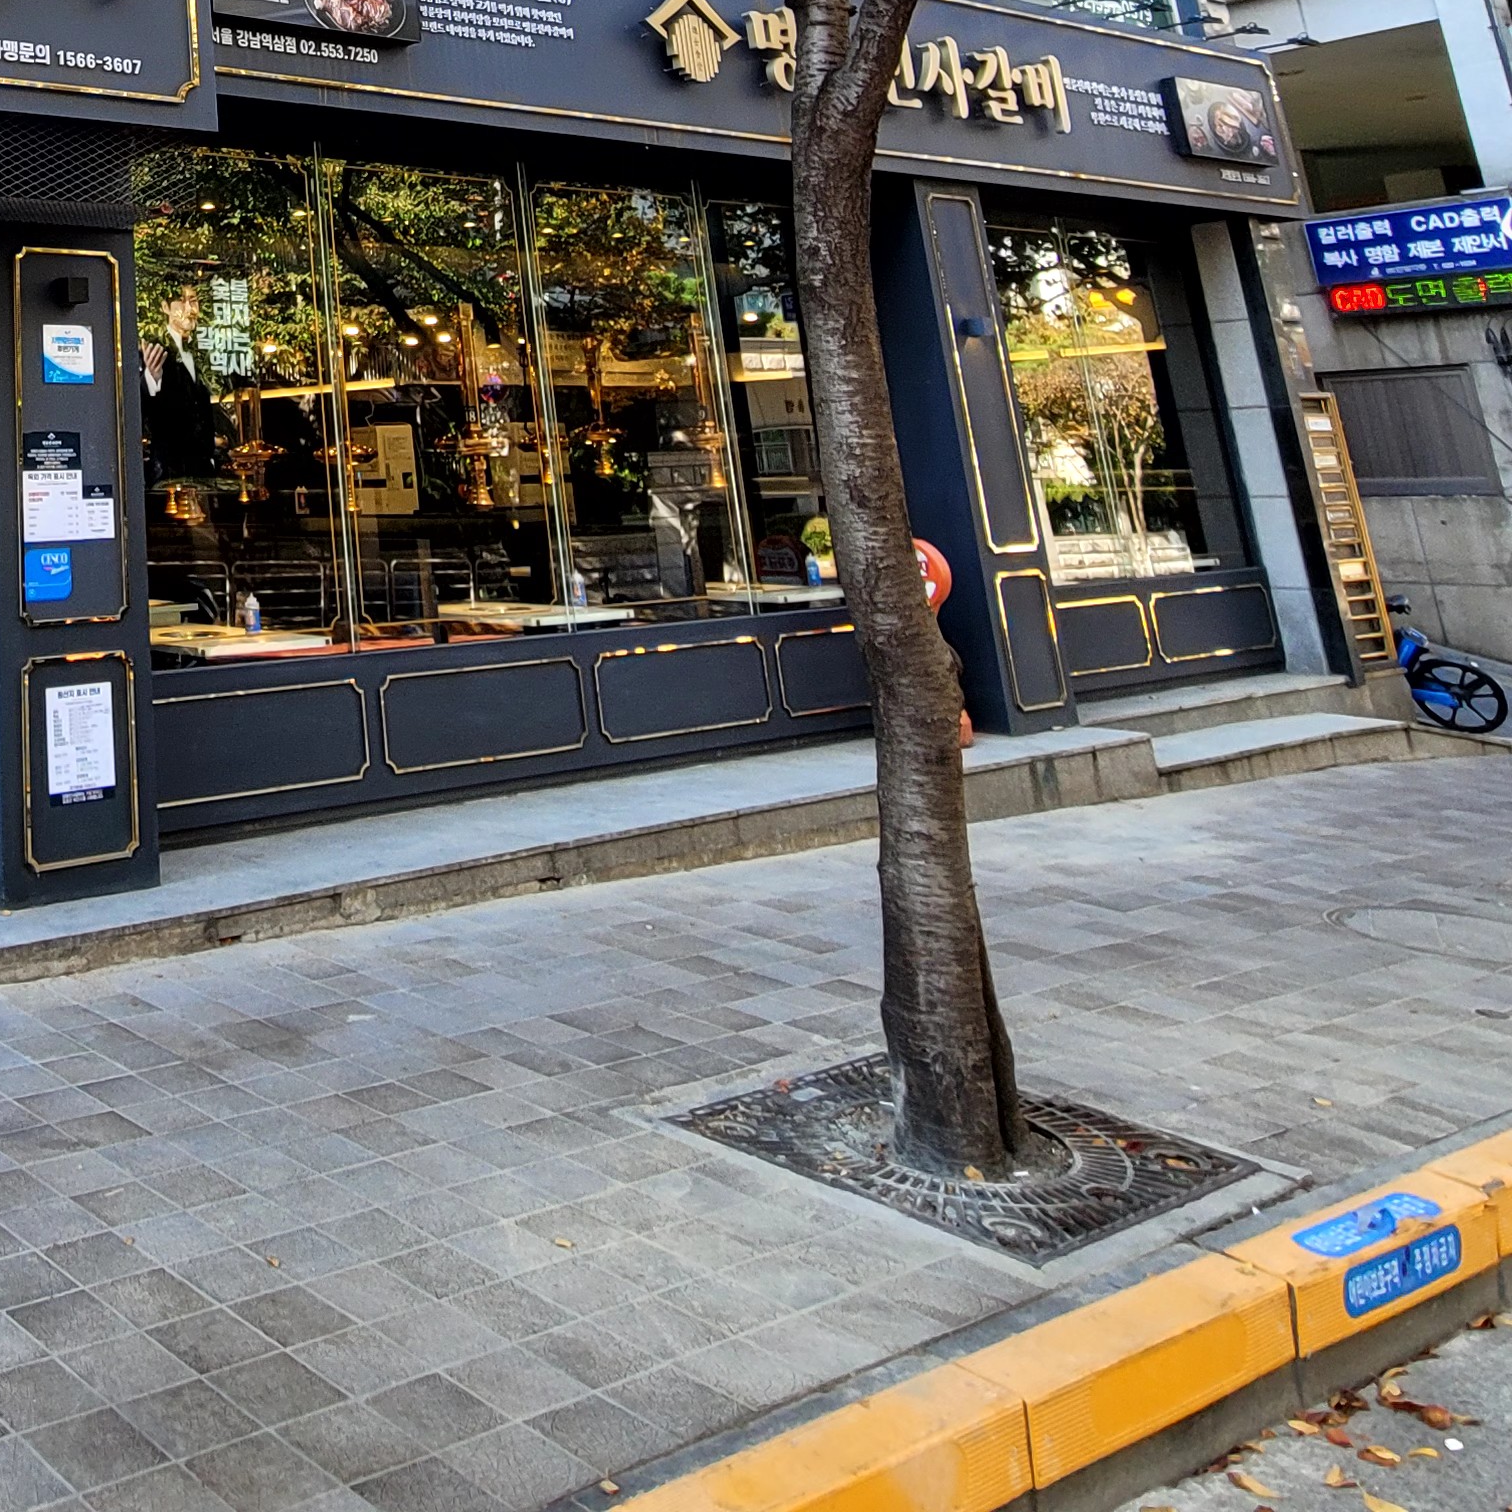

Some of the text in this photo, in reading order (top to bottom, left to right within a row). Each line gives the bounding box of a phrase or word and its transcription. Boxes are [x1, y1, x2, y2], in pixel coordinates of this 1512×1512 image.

[56, 48, 143, 77] 1566-3607
[236, 30, 297, 54] 강남역삼점
[300, 40, 379, 64] 02.553.7250
[741, 6, 1071, 134] 명사갈비
[1317, 205, 1502, 245] 컬러출력 CAD출력
[1323, 232, 1508, 268] 복사 명함 제본 제안서
